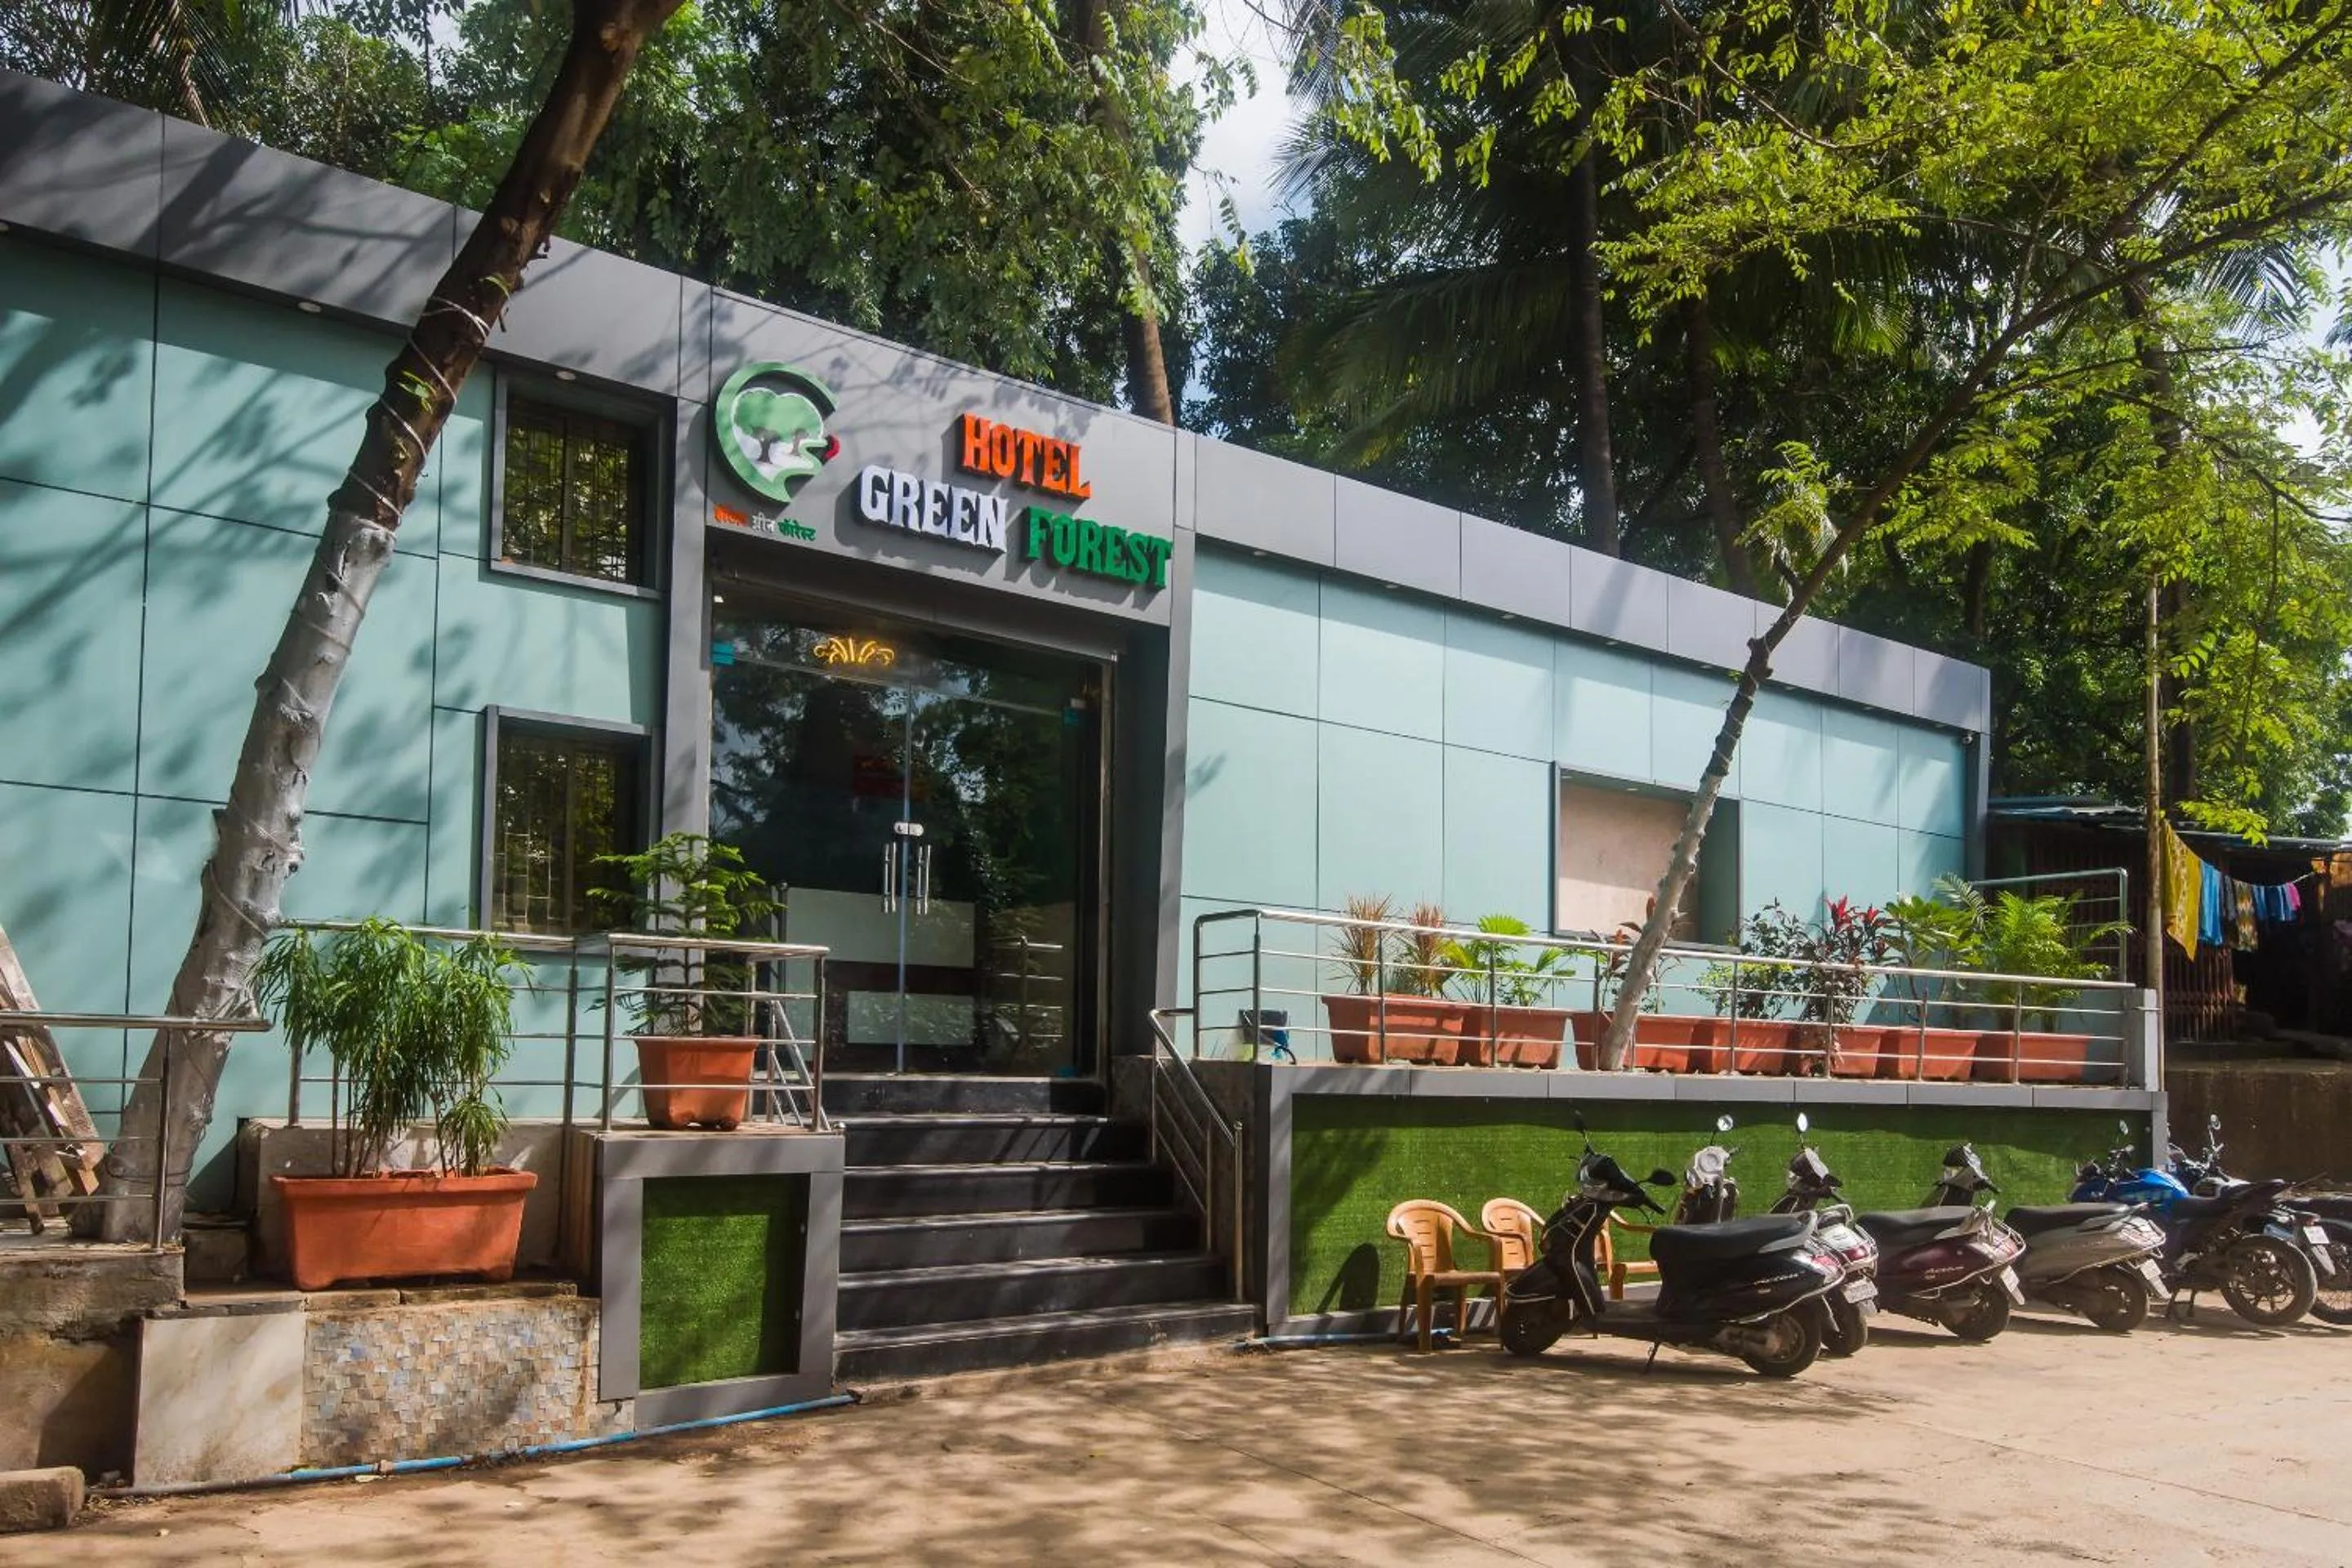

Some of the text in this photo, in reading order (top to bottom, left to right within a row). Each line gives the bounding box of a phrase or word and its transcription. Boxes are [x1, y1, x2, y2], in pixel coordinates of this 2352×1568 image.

[962, 412, 1090, 501] HOTEL
[860, 464, 1009, 554] GREEN
[1027, 506, 1174, 589] FOREST
